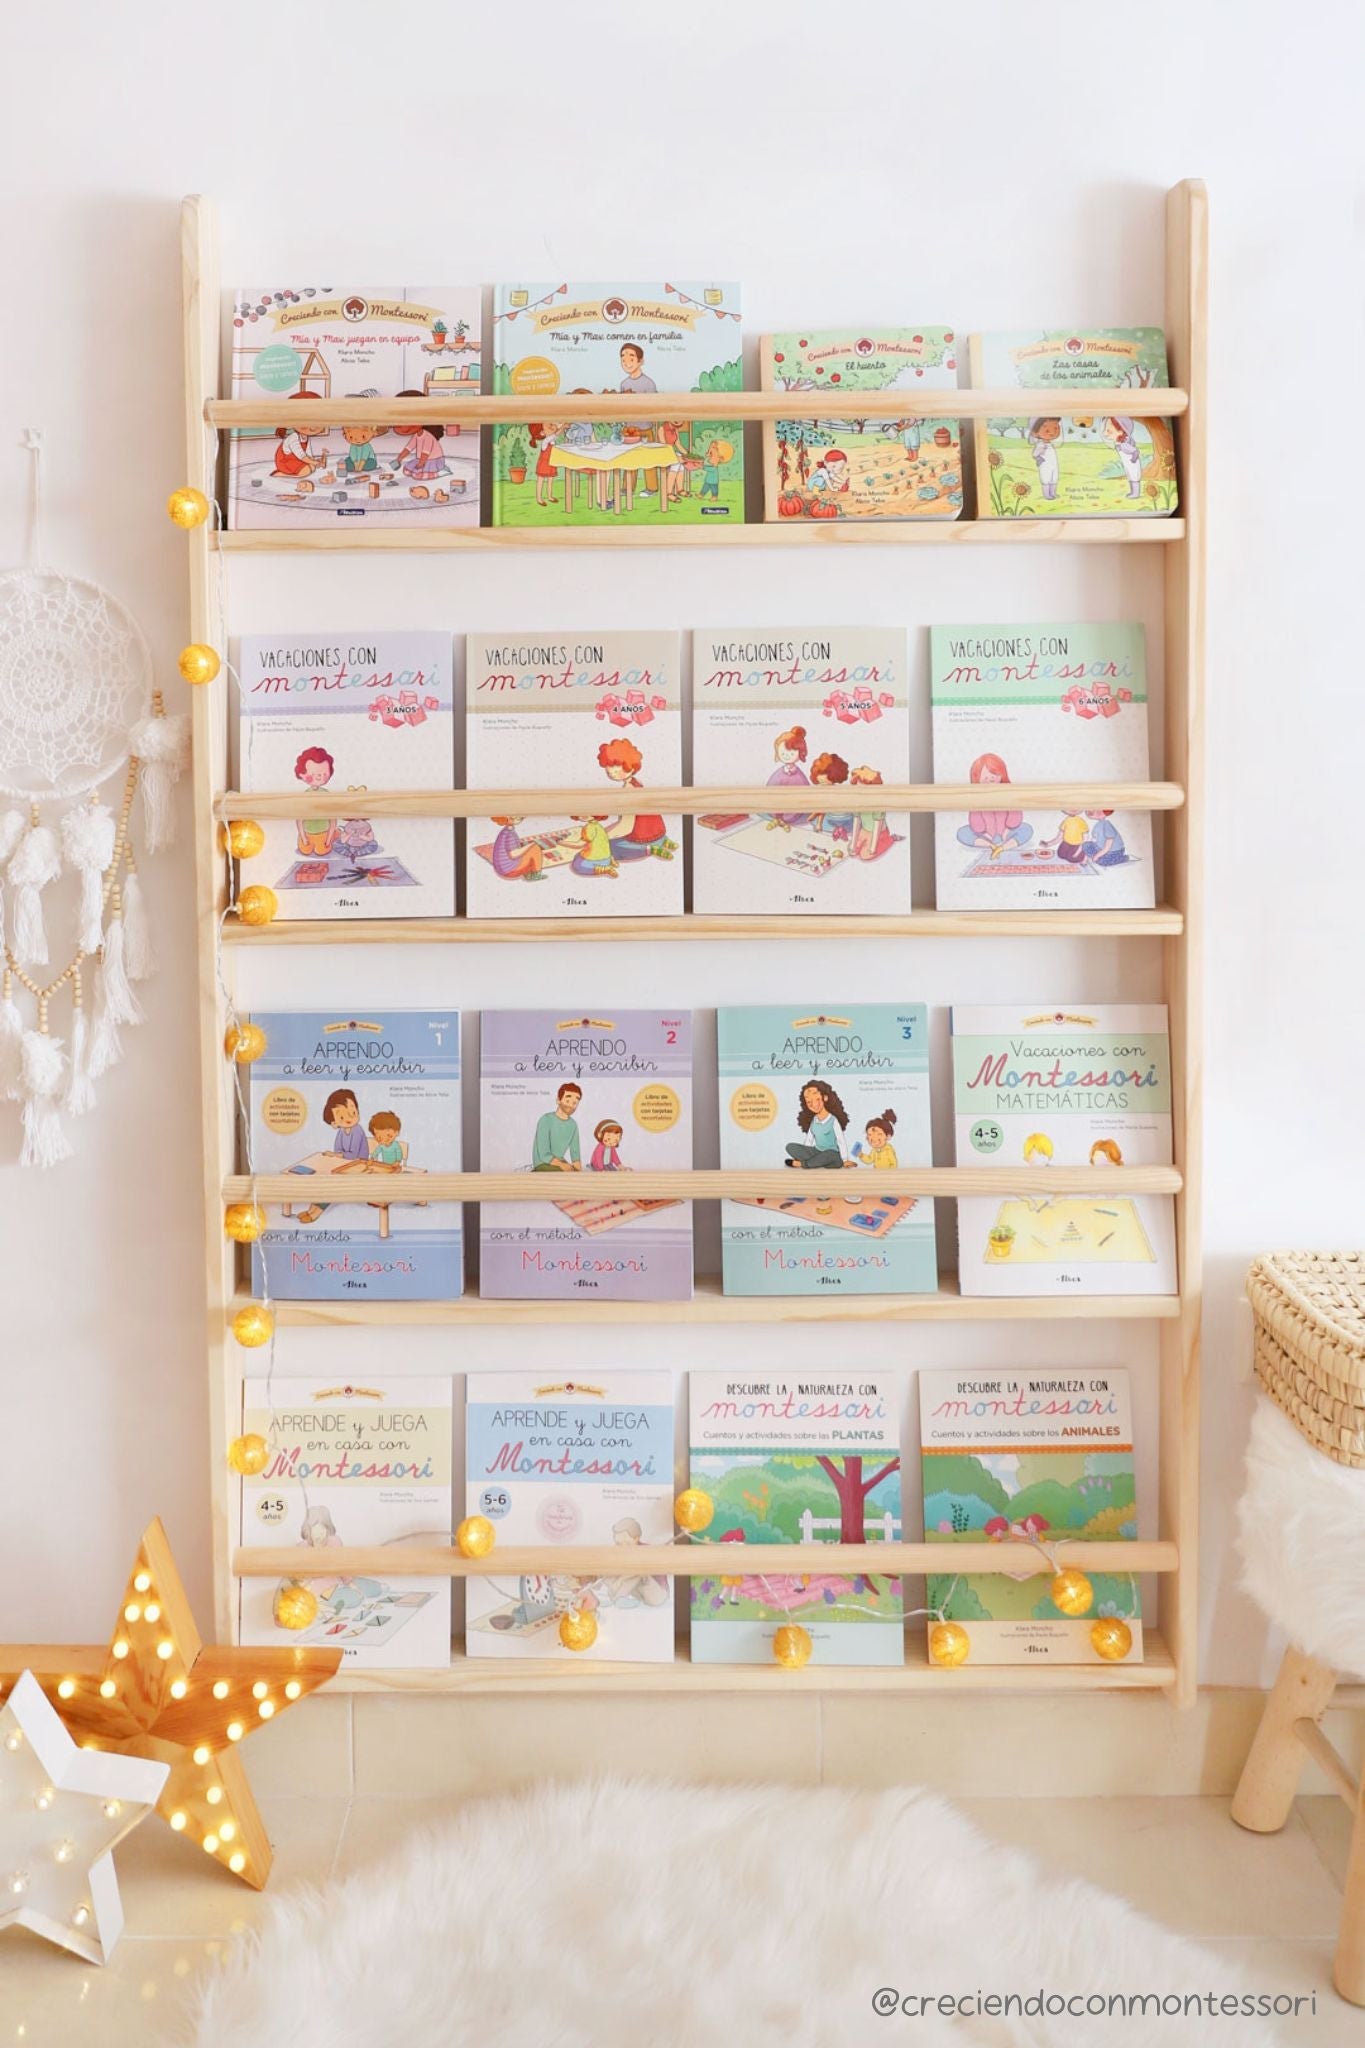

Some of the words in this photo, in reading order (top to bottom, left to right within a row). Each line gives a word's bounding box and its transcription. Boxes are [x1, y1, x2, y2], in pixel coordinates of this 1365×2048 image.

[371, 305, 429, 321] Montessori
[631, 306, 690, 323] Montessori
[345, 335, 376, 347] juegan
[391, 335, 420, 347] equipo
[572, 333, 580, 345] y
[606, 333, 635, 341] comen
[637, 333, 648, 341] en
[649, 331, 684, 344] familia
[846, 361, 855, 370] El
[856, 361, 887, 370] huerto
[1052, 360, 1071, 369] Las
[1073, 360, 1100, 368] casas
[1039, 370, 1051, 380] de
[1052, 370, 1068, 380] los
[1070, 368, 1113, 379] animales
[485, 646, 567, 666] VACACIONES
[574, 645, 604, 664] CON
[712, 642, 794, 663] VACACIONES
[801, 641, 831, 660] CON
[949, 638, 1032, 659] VACACIONES
[1039, 637, 1069, 656] CON
[259, 648, 340, 668] VACACIONES
[348, 647, 377, 665] CON
[476, 660, 668, 691] montessori
[704, 657, 896, 687] montessori
[942, 653, 1134, 683] montessori
[250, 662, 441, 694] montessori
[840, 702, 845, 710] 5
[846, 701, 872, 709] AÑOS
[1078, 697, 1084, 705] 6
[1086, 696, 1110, 705] AÑOS
[386, 705, 391, 714] 3
[392, 704, 417, 713] AÑOS
[613, 705, 618, 713] 4
[620, 704, 644, 713] AÑOS
[428, 1021, 449, 1029] Nivel
[661, 1019, 682, 1027] Nivel
[434, 1032, 443, 1046] 1
[666, 1031, 677, 1044] 2
[902, 1026, 912, 1040] 3
[313, 1041, 394, 1059] APRENDO
[545, 1039, 626, 1057] APRENDO
[782, 1035, 863, 1054] APRENDO
[1009, 1039, 1107, 1058] Vacaciones
[1112, 1045, 1146, 1057] con
[283, 1062, 295, 1074] a
[301, 1057, 333, 1074] leer
[338, 1063, 351, 1081] y
[356, 1057, 425, 1074] escribir
[514, 1061, 527, 1072] a
[533, 1056, 566, 1072] leer
[571, 1062, 583, 1078] y
[589, 1055, 658, 1072] escribir
[752, 1059, 764, 1070] a
[770, 1053, 803, 1070] leer
[808, 1059, 820, 1076] y
[826, 1051, 894, 1068] escribir
[966, 1053, 1159, 1089] Montessori
[996, 1090, 1129, 1110] MATEMÁTICAS
[975, 1127, 999, 1139] 4-5
[977, 1140, 996, 1148] años
[261, 1231, 284, 1242] con
[288, 1229, 300, 1242] el
[304, 1229, 351, 1242] método
[490, 1230, 514, 1241] con
[518, 1227, 531, 1240] el
[535, 1227, 583, 1240] método
[731, 1229, 755, 1240] con
[759, 1226, 772, 1239] el
[777, 1225, 824, 1239] método
[291, 1251, 417, 1273] Montessori
[521, 1249, 648, 1272] Montessori
[764, 1248, 891, 1270] Montessori
[726, 1384, 770, 1395] DESCUBRE
[776, 1384, 787, 1395] LA
[798, 1384, 854, 1396] NATURALEZA
[858, 1384, 877, 1396] CON
[957, 1382, 1002, 1393] DESCUBRE
[1007, 1382, 1018, 1393] LA
[1029, 1381, 1085, 1392] NATURALEZA
[1090, 1380, 1109, 1391] CON
[700, 1391, 886, 1419] montessori
[931, 1387, 1118, 1417] montessori
[269, 1414, 346, 1433] APRENDE
[353, 1423, 364, 1439] y
[370, 1414, 428, 1433] JUEGA
[491, 1410, 568, 1428] APRENDE
[575, 1419, 585, 1436] y
[592, 1412, 650, 1430] JUEGA
[703, 1431, 737, 1439] Cuentos
[746, 1431, 792, 1439] actividades
[794, 1431, 817, 1439] sobre
[819, 1431, 830, 1439] las
[832, 1431, 884, 1440] PLANTAS
[931, 1430, 965, 1438] Cuentos
[967, 1432, 972, 1440] y
[974, 1429, 1021, 1438] actividades
[1022, 1428, 1045, 1437] sobre
[1047, 1428, 1059, 1436] los
[1061, 1426, 1121, 1436] ANIMALES
[306, 1440, 330, 1451] en
[334, 1440, 373, 1451] casa
[378, 1439, 411, 1451] con
[529, 1435, 551, 1447] en
[557, 1436, 595, 1447] casa
[600, 1437, 632, 1448] con
[262, 1446, 434, 1480] Montessori
[485, 1441, 656, 1476] Montessori
[261, 1500, 284, 1511] 4-5
[484, 1494, 507, 1506] 5-6
[262, 1511, 282, 1520] años
[486, 1506, 504, 1514] años
